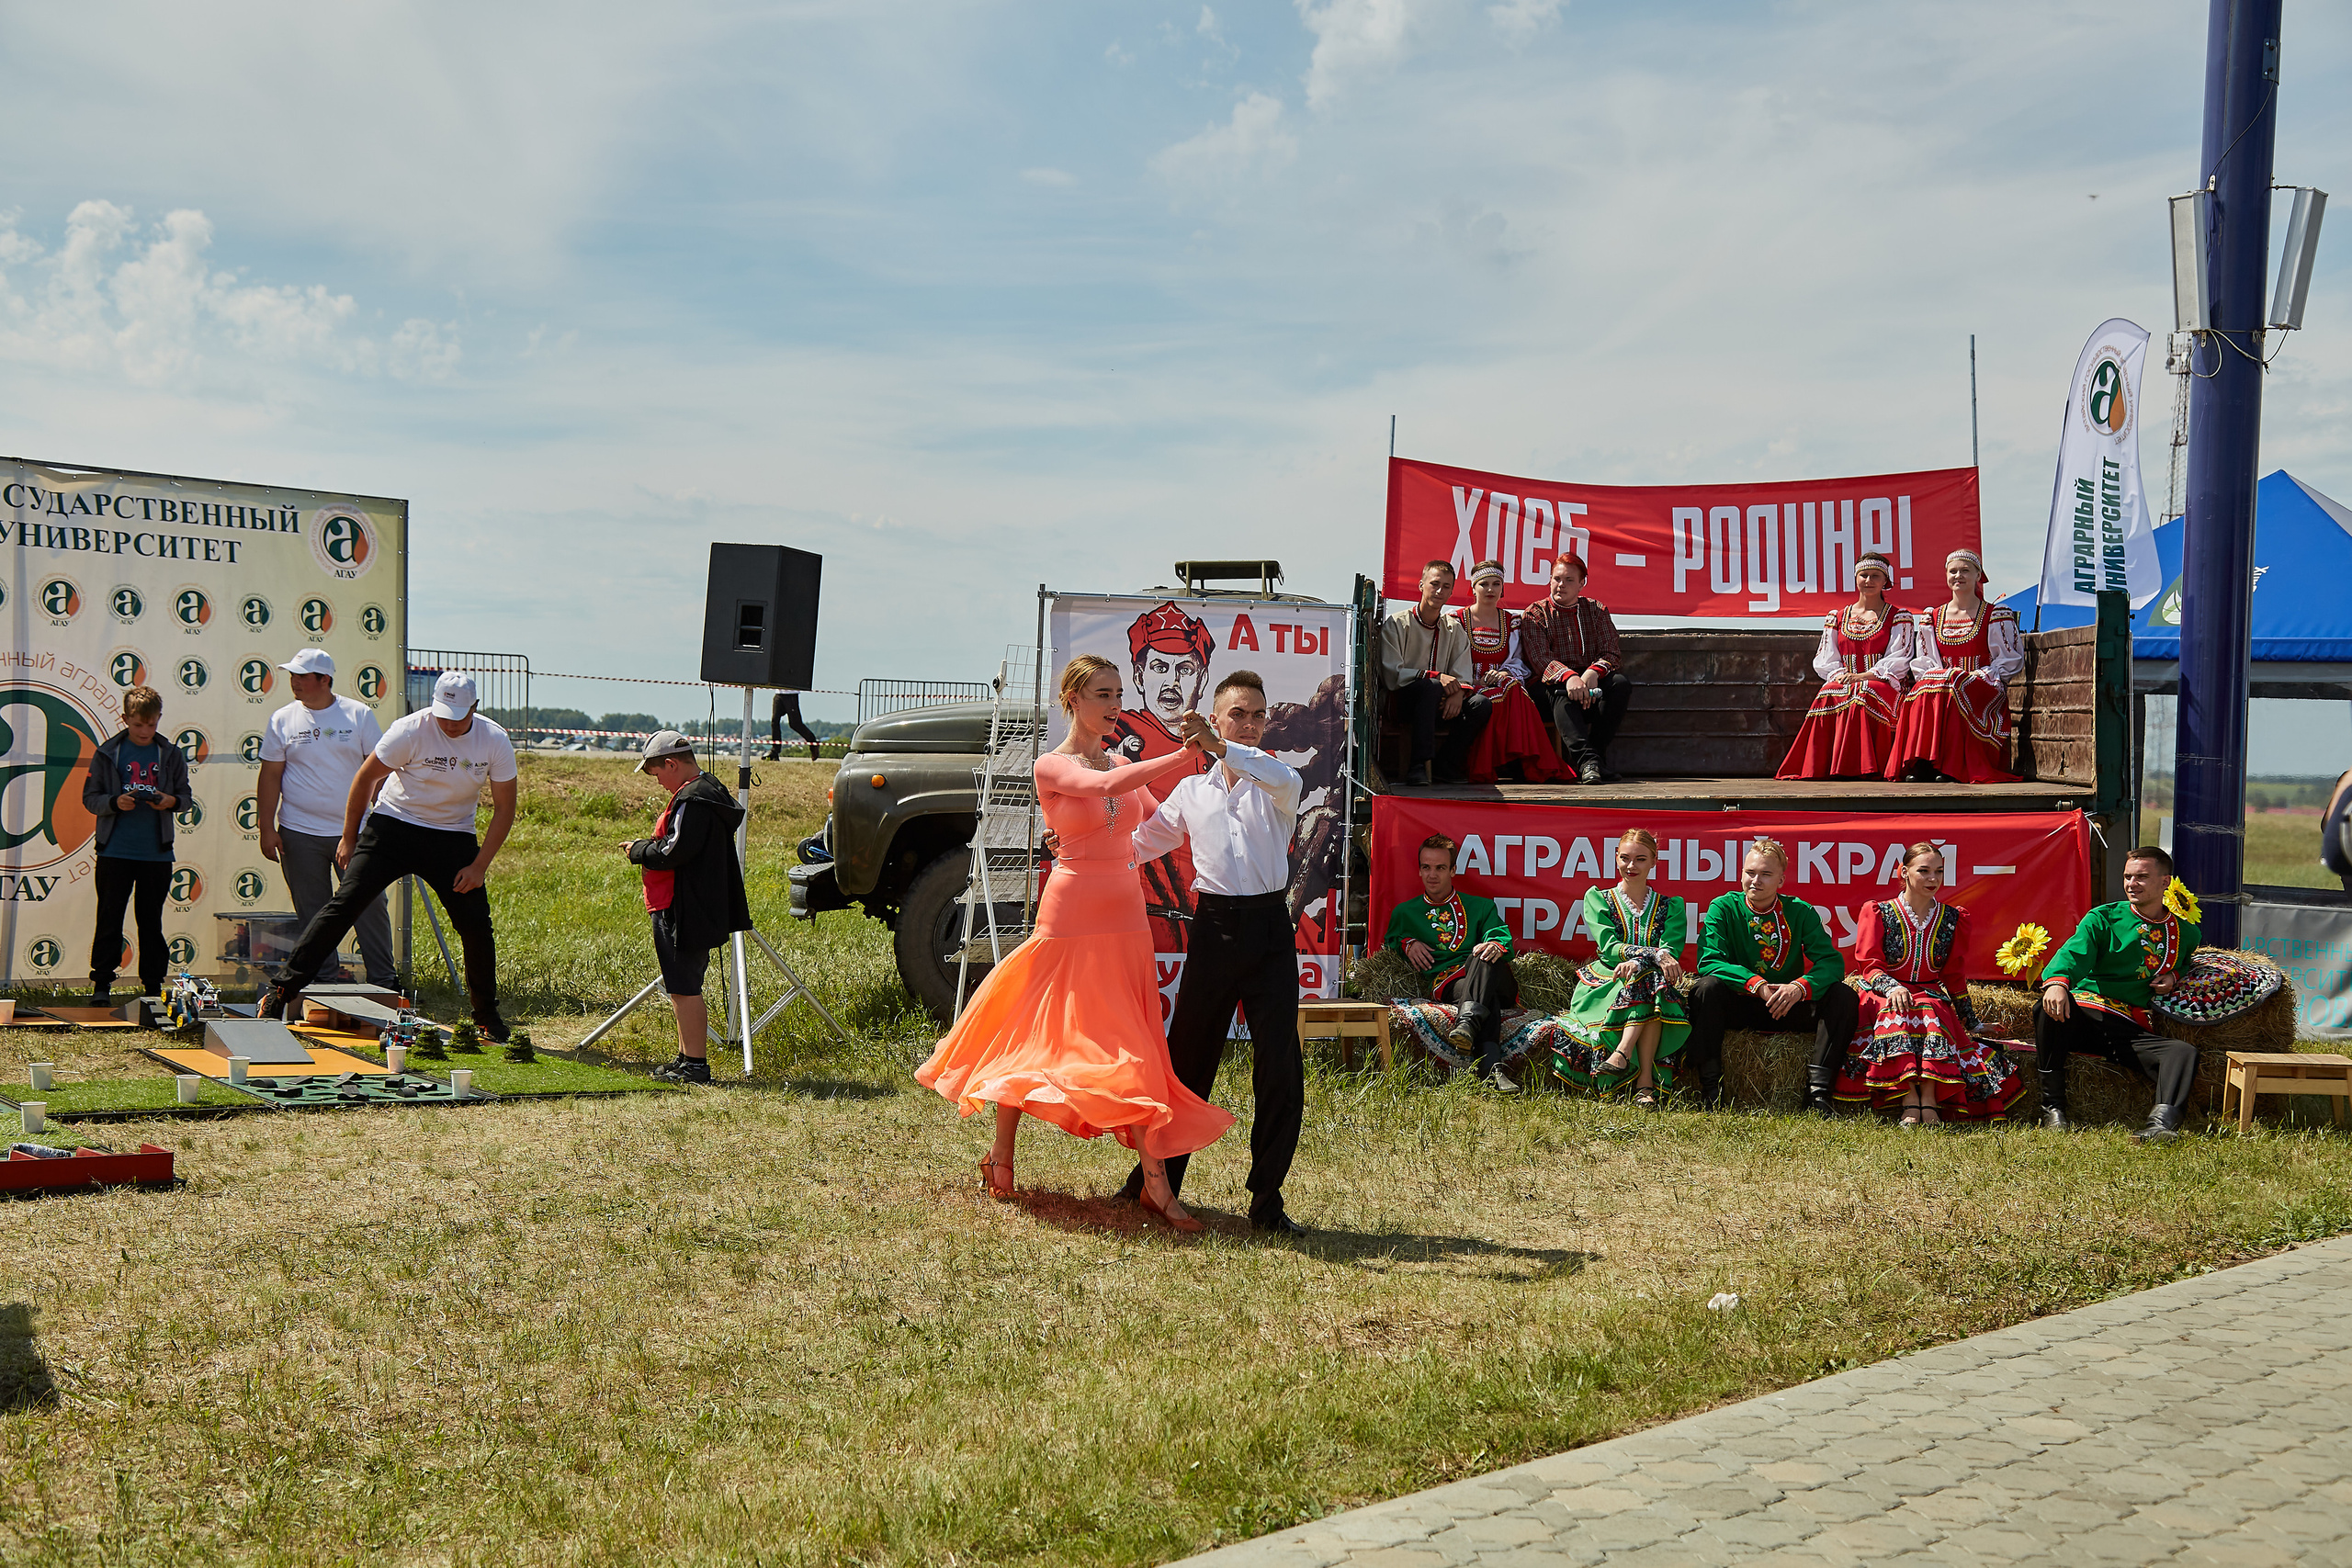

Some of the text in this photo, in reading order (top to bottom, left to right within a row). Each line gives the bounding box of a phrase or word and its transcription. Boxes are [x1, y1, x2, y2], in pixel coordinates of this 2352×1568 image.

[3, 483, 301, 534] СУДАРСТВЕННЫЙ
[2074, 478, 2097, 595] АГРАРНЫЙ
[334, 570, 357, 579] АГАУ
[1227, 614, 1260, 651] А
[2280, 965, 2352, 992] РСИТ
